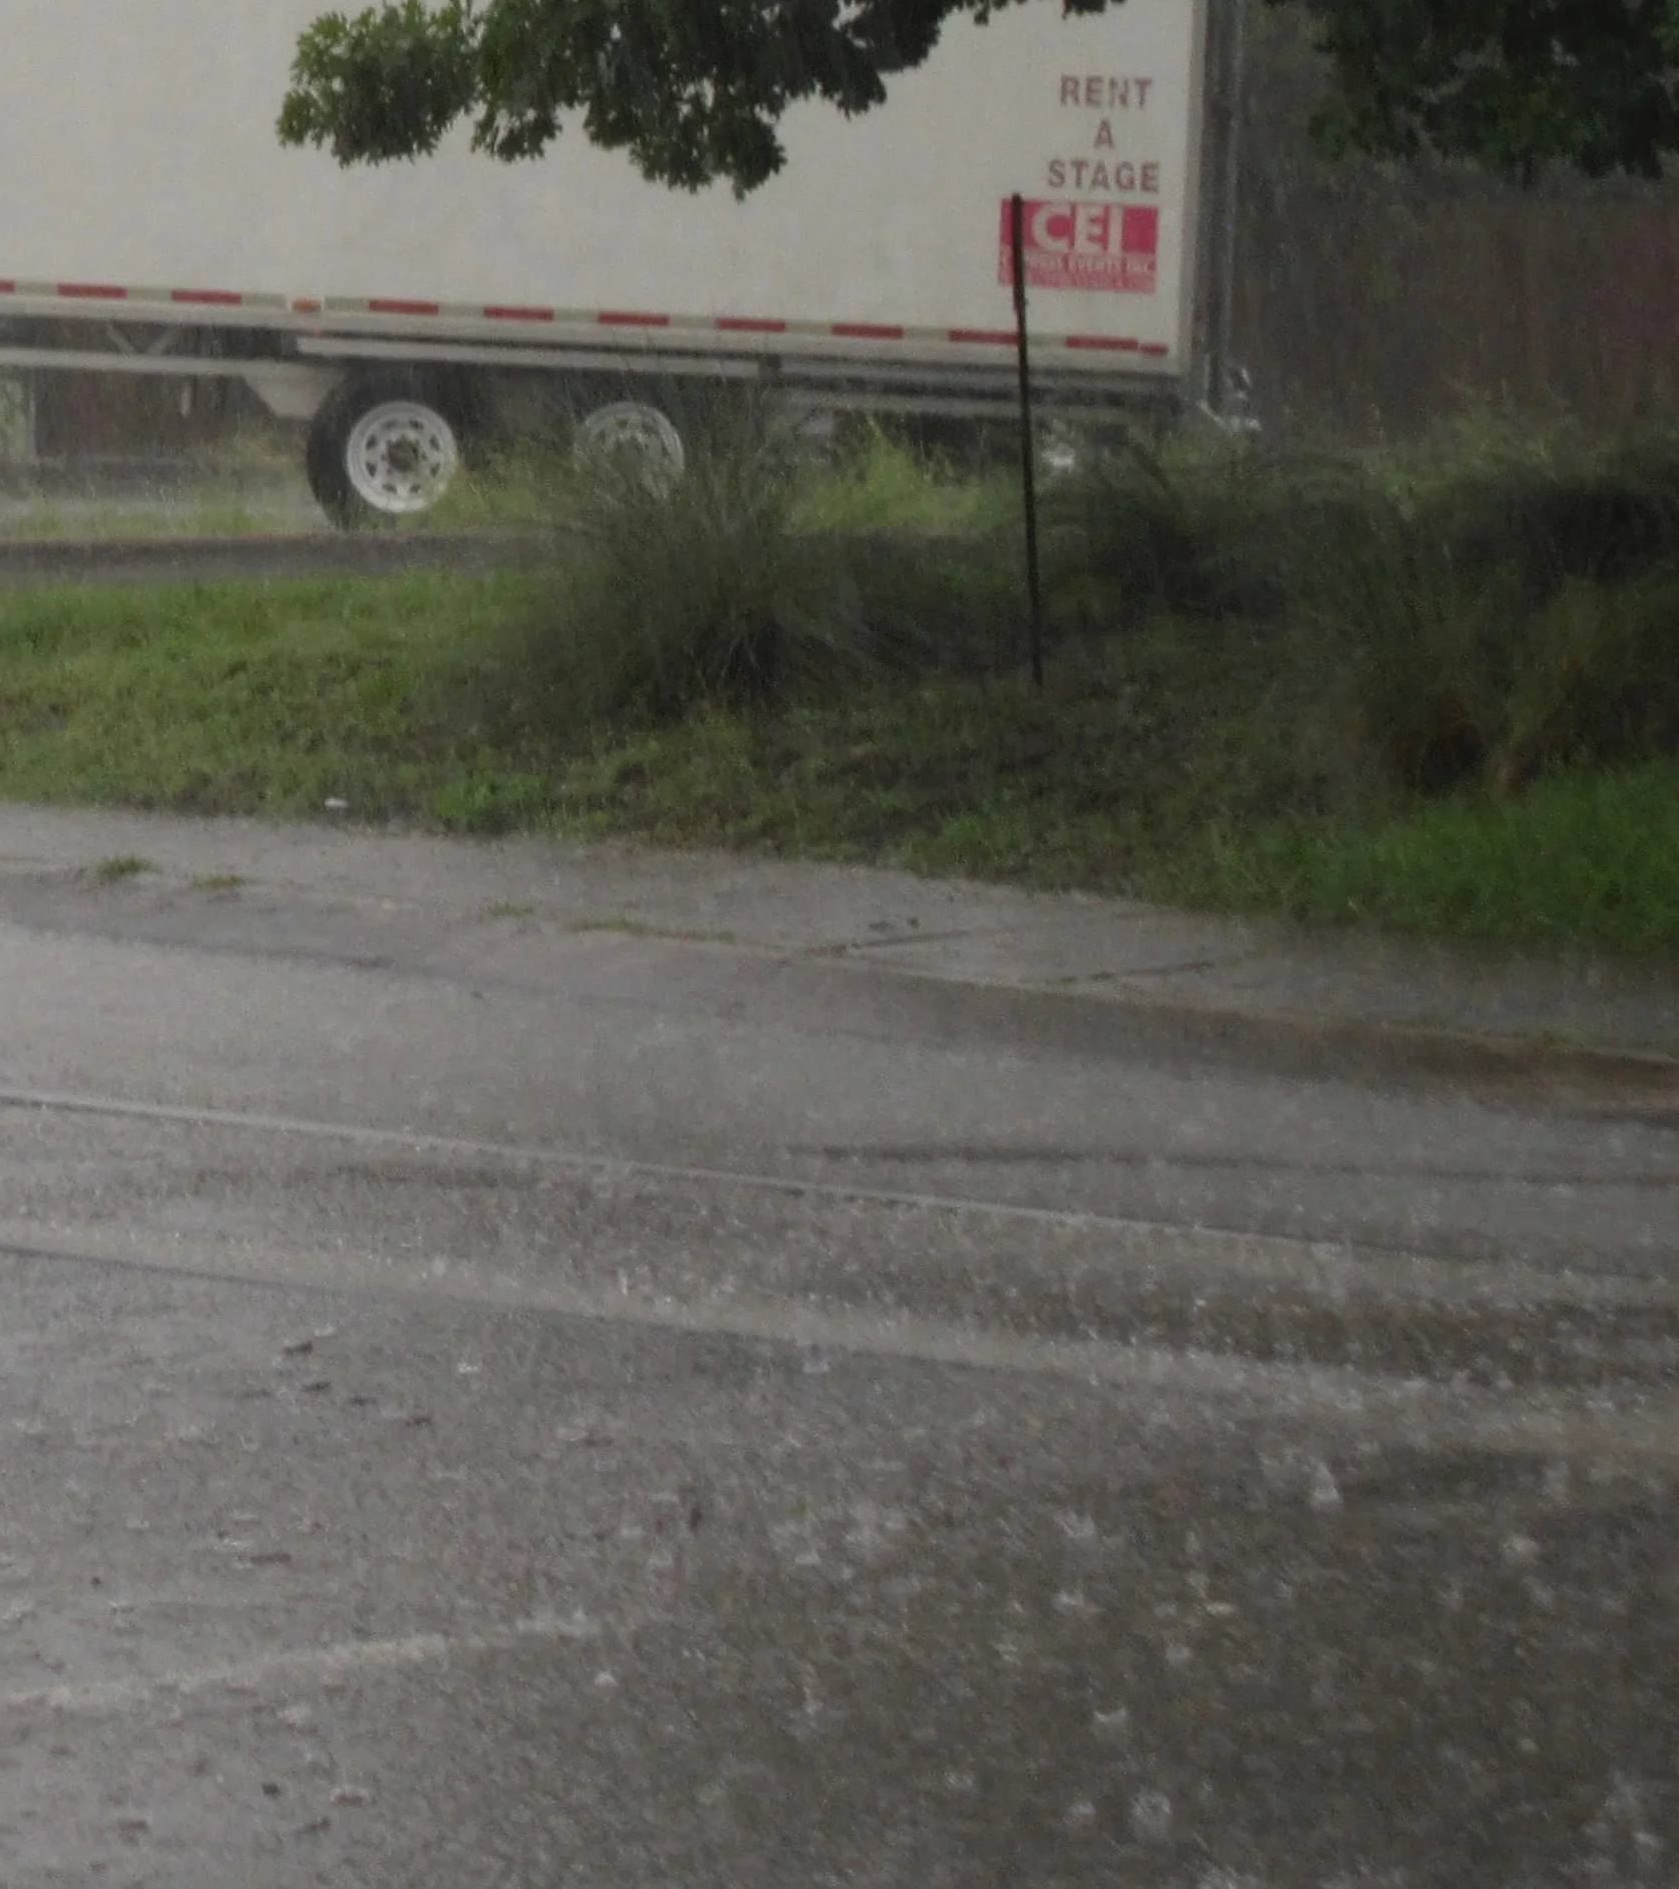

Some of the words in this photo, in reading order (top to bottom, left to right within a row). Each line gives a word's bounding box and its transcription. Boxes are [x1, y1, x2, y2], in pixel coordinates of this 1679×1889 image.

[1059, 74, 1153, 109] RENT
[1093, 118, 1115, 150] A
[1046, 158, 1160, 193] STAGE
[1032, 200, 1124, 254] CEI
